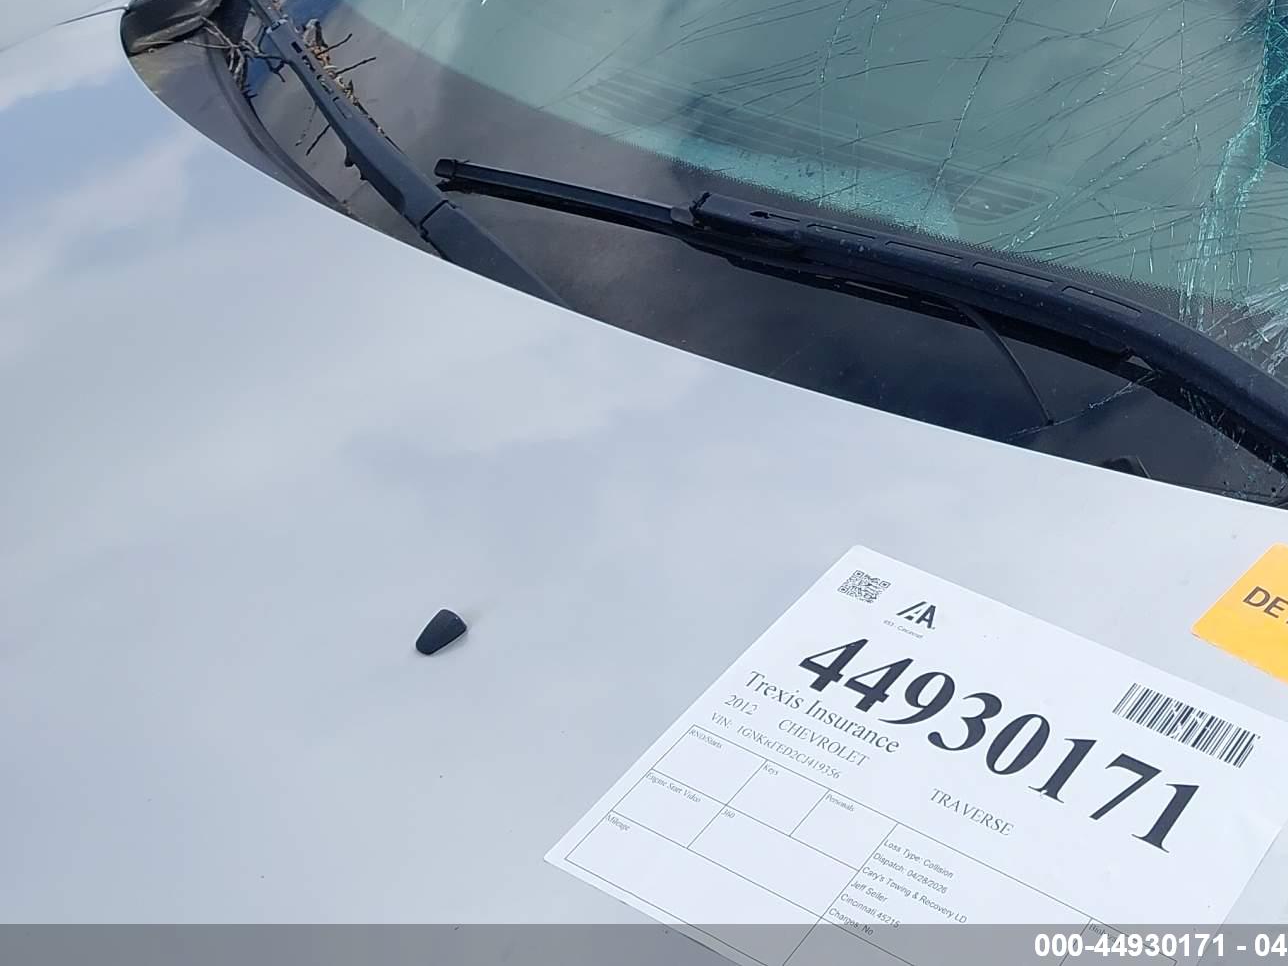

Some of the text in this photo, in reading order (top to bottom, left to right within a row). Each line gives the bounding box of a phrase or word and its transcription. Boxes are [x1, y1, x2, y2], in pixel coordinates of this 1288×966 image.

[711, 712, 732, 729] VIN:
[724, 694, 870, 766] 2012 CHEVROLET
[745, 670, 900, 754] Trexis Insurance
[799, 638, 1200, 853] 44930171
[763, 764, 779, 776] Keys
[930, 788, 1014, 836] TRAVERSE
[873, 852, 948, 894] Dispatch: 04/28/2026
[884, 839, 901, 853] Loss
[923, 858, 954, 879] Collision
[851, 880, 866, 892] Jeff
[862, 866, 885, 883] Cary's
[887, 877, 912, 897] Towing
[912, 891, 920, 899] &
[920, 895, 955, 919] Recovery
[861, 924, 874, 936] No
